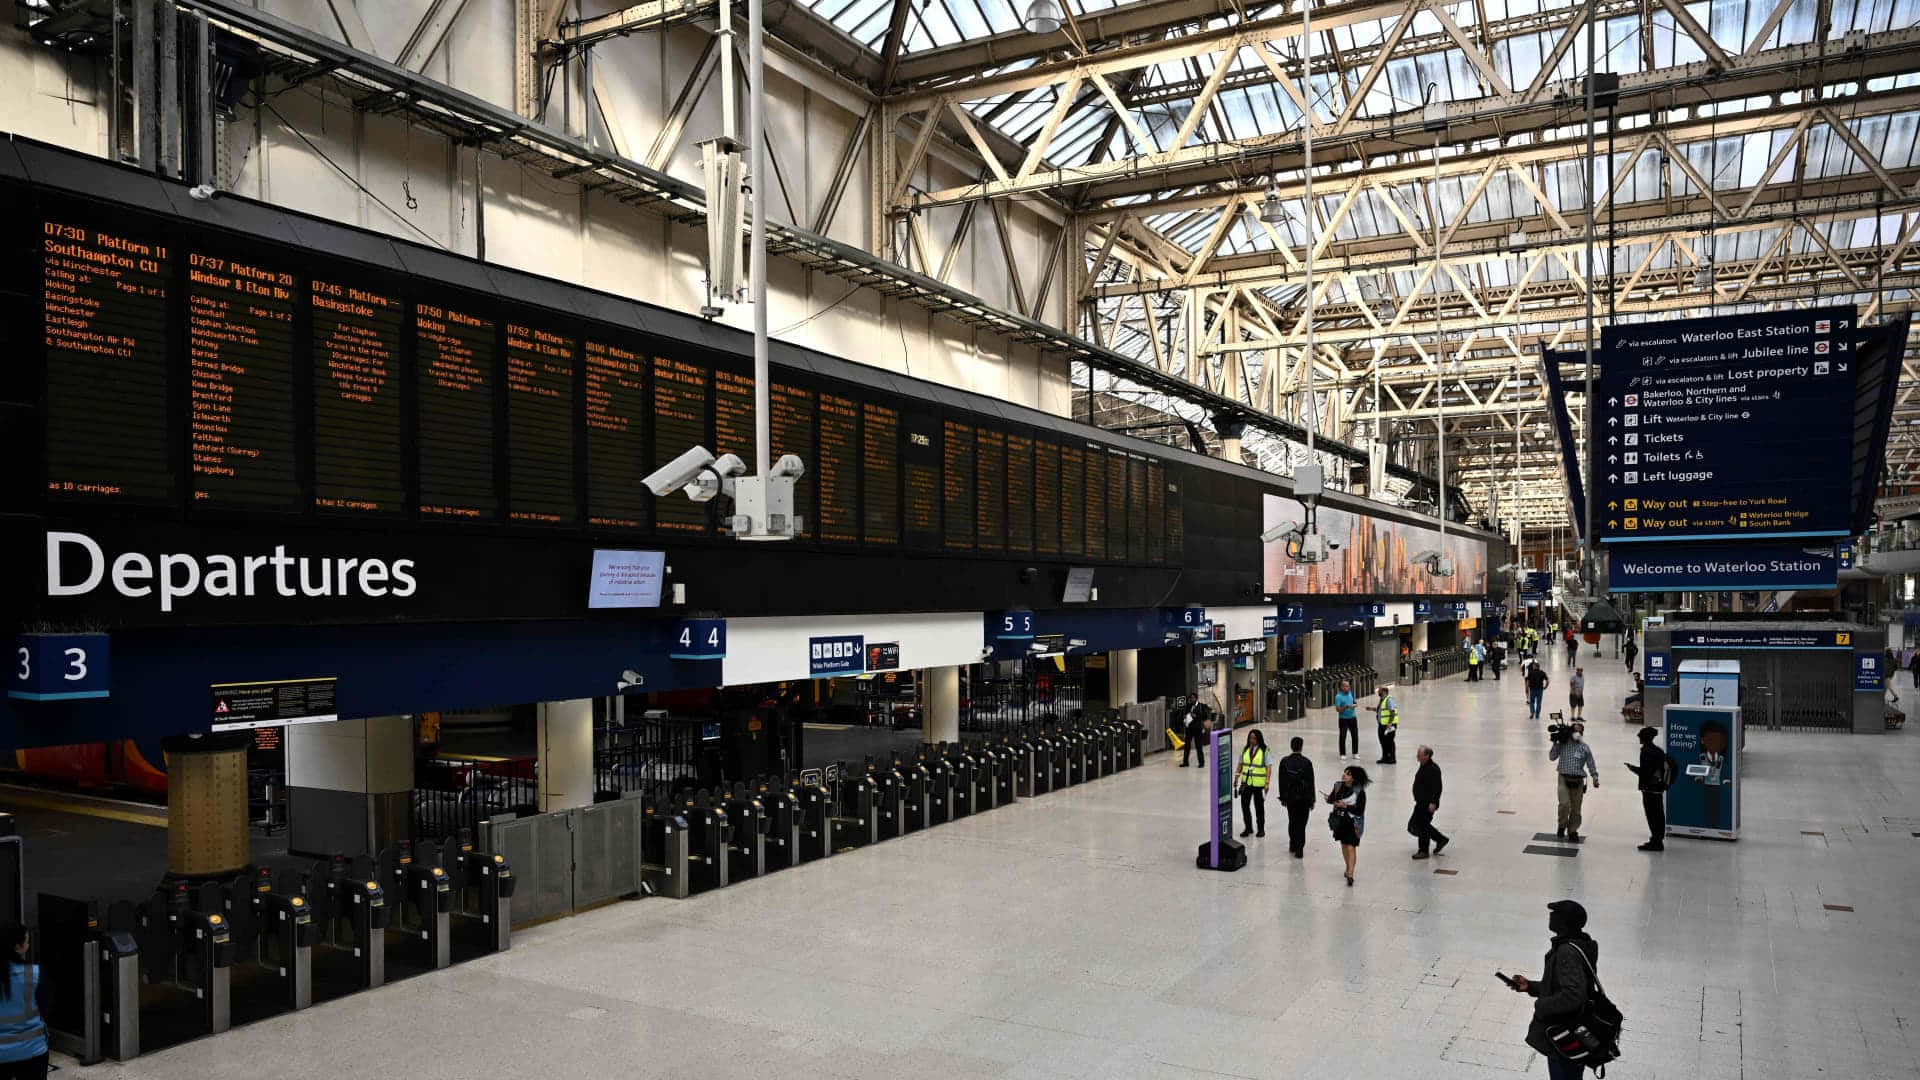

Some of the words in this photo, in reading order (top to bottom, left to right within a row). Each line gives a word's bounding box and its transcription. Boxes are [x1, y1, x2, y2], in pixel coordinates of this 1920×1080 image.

[44, 222, 85, 241] 07:30
[97, 233, 149, 255] Platform
[156, 246, 167, 259] 11
[44, 239, 134, 270] Southampton
[45, 267, 75, 282] Calling
[63, 259, 121, 278] Winchester
[190, 253, 224, 271] 07:37
[231, 263, 275, 282] Platform
[279, 273, 293, 286] 20
[45, 280, 76, 293] Woking
[116, 281, 136, 293] Page
[147, 287, 157, 296] of
[190, 270, 231, 288] Windsor
[236, 279, 242, 290] &
[246, 281, 270, 297] Eton
[45, 291, 100, 307] Basingstoke
[312, 280, 342, 296] 07:45
[349, 288, 387, 306] Platform
[45, 302, 96, 318] Winchester
[191, 295, 216, 308] Calling
[249, 306, 267, 317] Page
[312, 295, 374, 317] Basingstoke
[45, 313, 88, 328] Eastleigh
[417, 303, 442, 318] 07:50
[448, 310, 481, 327] Platform
[191, 317, 222, 329] Clapham
[224, 323, 256, 335] Junction
[417, 317, 446, 333] Woking
[46, 325, 104, 342] Southampton
[191, 327, 237, 342] Wandsworth
[240, 335, 259, 345] Town
[534, 329, 563, 345] Platform
[1641, 337, 1678, 347] escalators
[1682, 331, 1734, 344] Waterloo
[1737, 329, 1762, 340] East
[1766, 324, 1810, 337] Station
[57, 338, 114, 355] Southampton
[191, 337, 219, 350] Putney
[191, 348, 218, 359] Barnes
[1682, 354, 1719, 363] escalators
[1728, 352, 1739, 360] lift
[1742, 348, 1784, 359] Jubilee
[1787, 344, 1809, 356] line
[192, 359, 218, 369] Barnes
[221, 363, 245, 375] Bridge
[1667, 375, 1704, 384] escalators
[1713, 373, 1724, 381] lift
[1728, 369, 1753, 380] Lost
[1757, 365, 1809, 380] property
[192, 380, 207, 389] Kew
[209, 382, 233, 393] Bridge
[1643, 390, 1684, 399] Bakerloo,
[1686, 387, 1727, 397] Northern
[1729, 385, 1746, 393] and
[192, 390, 232, 402] Brentford
[1643, 398, 1683, 408] Waterloo
[1686, 396, 1693, 405] &
[1695, 396, 1713, 406] City
[1715, 394, 1737, 403] lines
[192, 401, 211, 411] Syon
[213, 404, 231, 412] Lane
[193, 412, 231, 422] Isleworth
[1643, 414, 1662, 424] Lift
[1666, 415, 1699, 423] Waterloo
[1700, 414, 1706, 422] &
[1708, 413, 1723, 423] City
[1725, 412, 1739, 420] line
[192, 422, 228, 433] Hounslow
[193, 432, 224, 442] Feltham
[1644, 433, 1684, 444] Tickets
[193, 443, 225, 453] Ashford
[1643, 452, 1681, 463] Toilets
[193, 464, 235, 476] Wraysbury
[1643, 471, 1666, 482] Left
[1668, 470, 1713, 482] luggage
[63, 482, 73, 490] 10
[1642, 500, 1666, 511] Way
[1668, 499, 1688, 509] out
[1749, 498, 1766, 506] York
[1767, 497, 1787, 505] Road
[1749, 511, 1783, 519] Waterloo
[1784, 510, 1809, 518] Bridge
[1642, 518, 1666, 530] Way
[1668, 518, 1688, 528] out
[1750, 519, 1772, 527] South
[1773, 519, 1791, 527] Bank
[47, 530, 417, 612] Departures
[1623, 563, 1684, 575] Welcome
[1687, 562, 1701, 574] to
[1704, 561, 1767, 573] Waterloo
[1770, 559, 1821, 572] Station
[1287, 608, 1294, 617] 7
[1372, 605, 1378, 614] 8
[1418, 603, 1425, 611] 9
[1004, 616, 1013, 631] 5
[1024, 616, 1030, 631] 5
[1184, 611, 1193, 623] 6
[679, 627, 692, 647] 4
[708, 627, 719, 647] 4
[1706, 636, 1744, 644] Underground
[1840, 634, 1846, 643] 7
[18, 647, 30, 680] 3
[63, 647, 87, 681] 3
[1670, 723, 1688, 732] How
[1670, 739, 1697, 749] doing?
